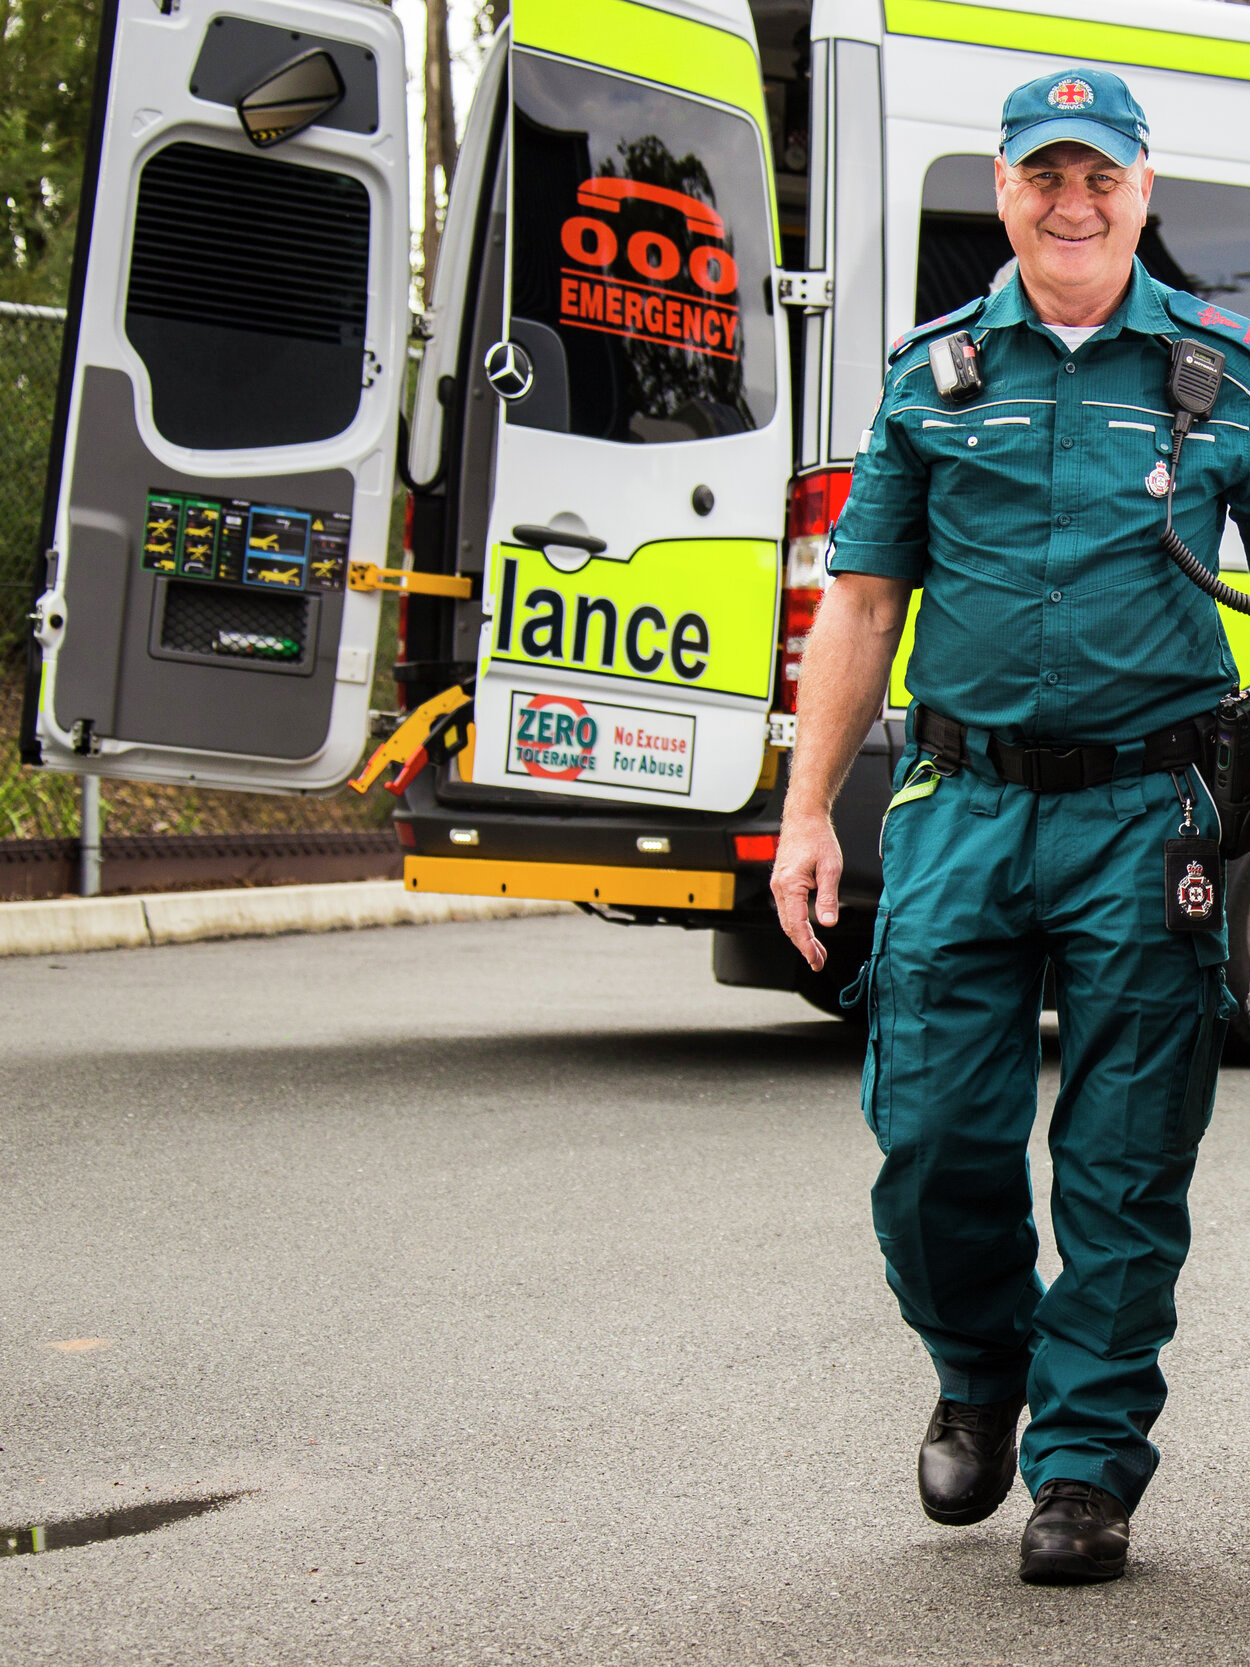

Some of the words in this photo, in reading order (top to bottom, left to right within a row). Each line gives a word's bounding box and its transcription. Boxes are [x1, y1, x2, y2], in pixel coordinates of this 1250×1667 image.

[560, 277, 738, 349] EMERGENCY
[497, 557, 710, 681] lance
[516, 708, 598, 749] ZERO
[614, 726, 633, 748] No
[636, 729, 687, 754] Excuse
[515, 746, 596, 771] TOLERANCE
[613, 751, 636, 772] For
[638, 755, 684, 778] Abuse
